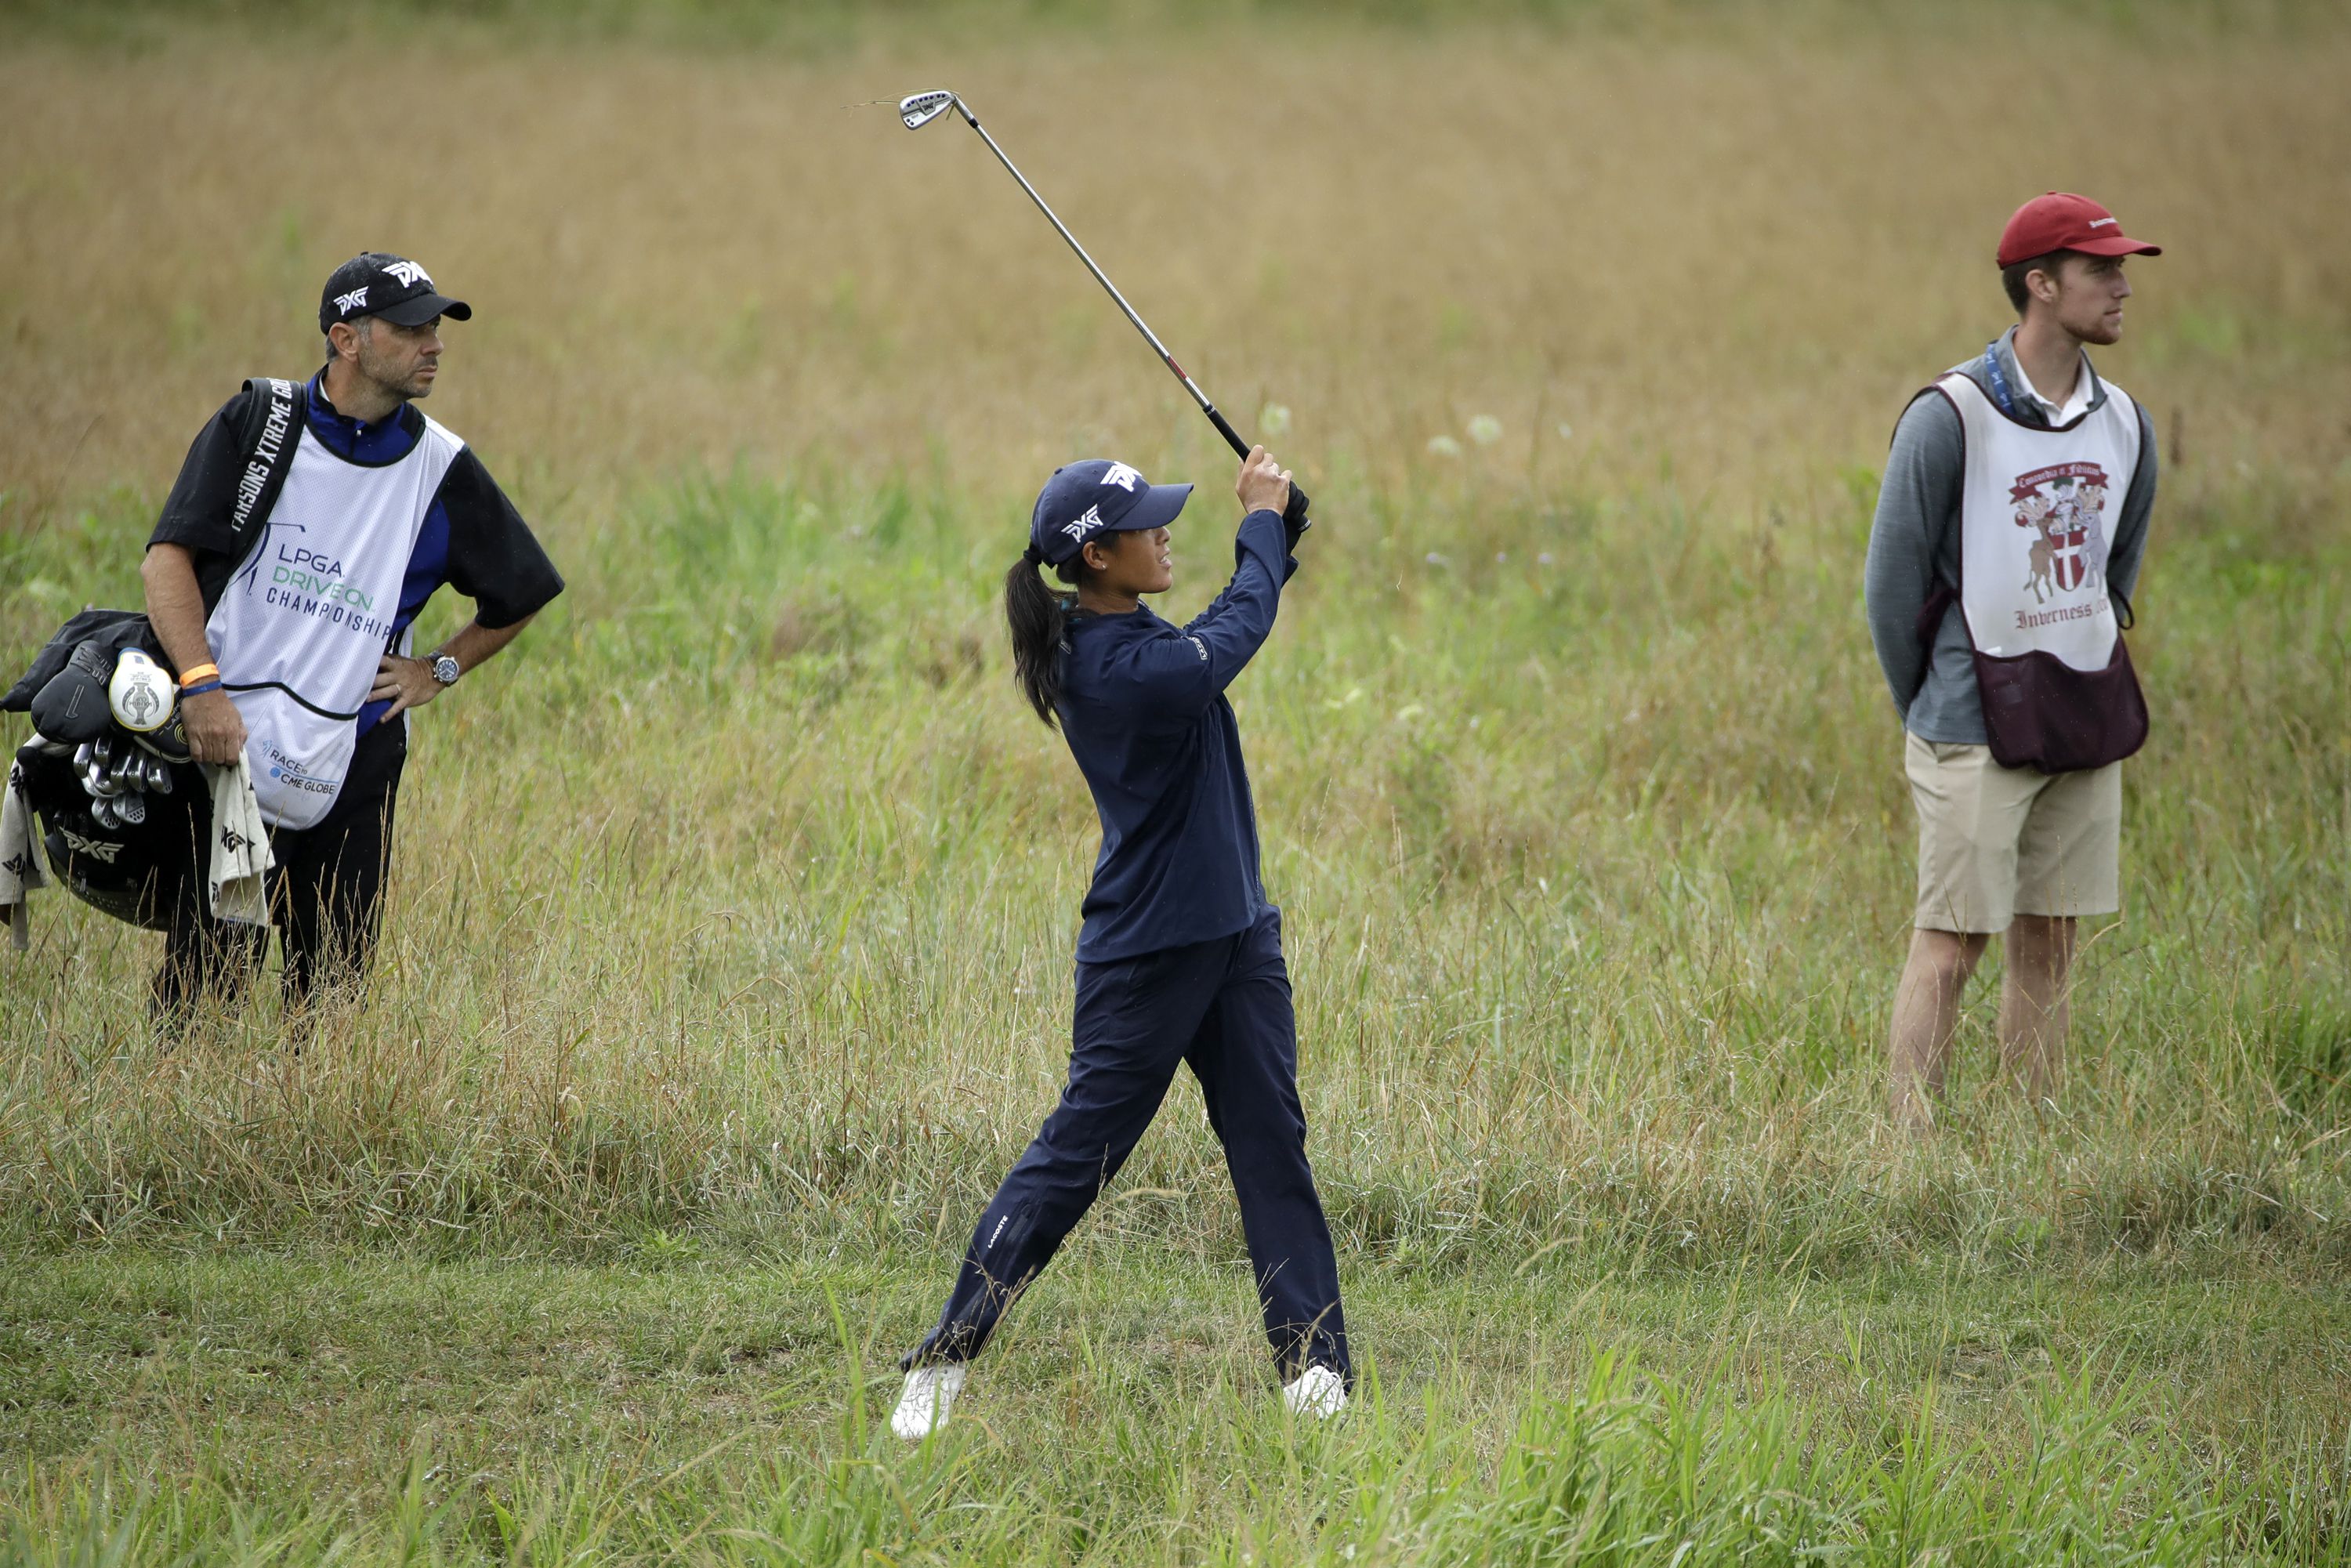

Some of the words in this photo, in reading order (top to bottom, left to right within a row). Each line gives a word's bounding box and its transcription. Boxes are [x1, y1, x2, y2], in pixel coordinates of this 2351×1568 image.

[333, 286, 369, 317] PXG
[254, 397, 292, 464] XTREME
[1060, 503, 1104, 543] PXG
[278, 544, 342, 578] LPGA
[273, 565, 345, 599] DRIVE
[344, 588, 374, 612] ON
[2015, 603, 2093, 628] Inverness
[270, 749, 303, 774] RACE
[281, 773, 304, 789] CME
[304, 781, 336, 795] GLOBE
[59, 826, 125, 864] PXG
[987, 1215, 1009, 1249] LACOSTE
